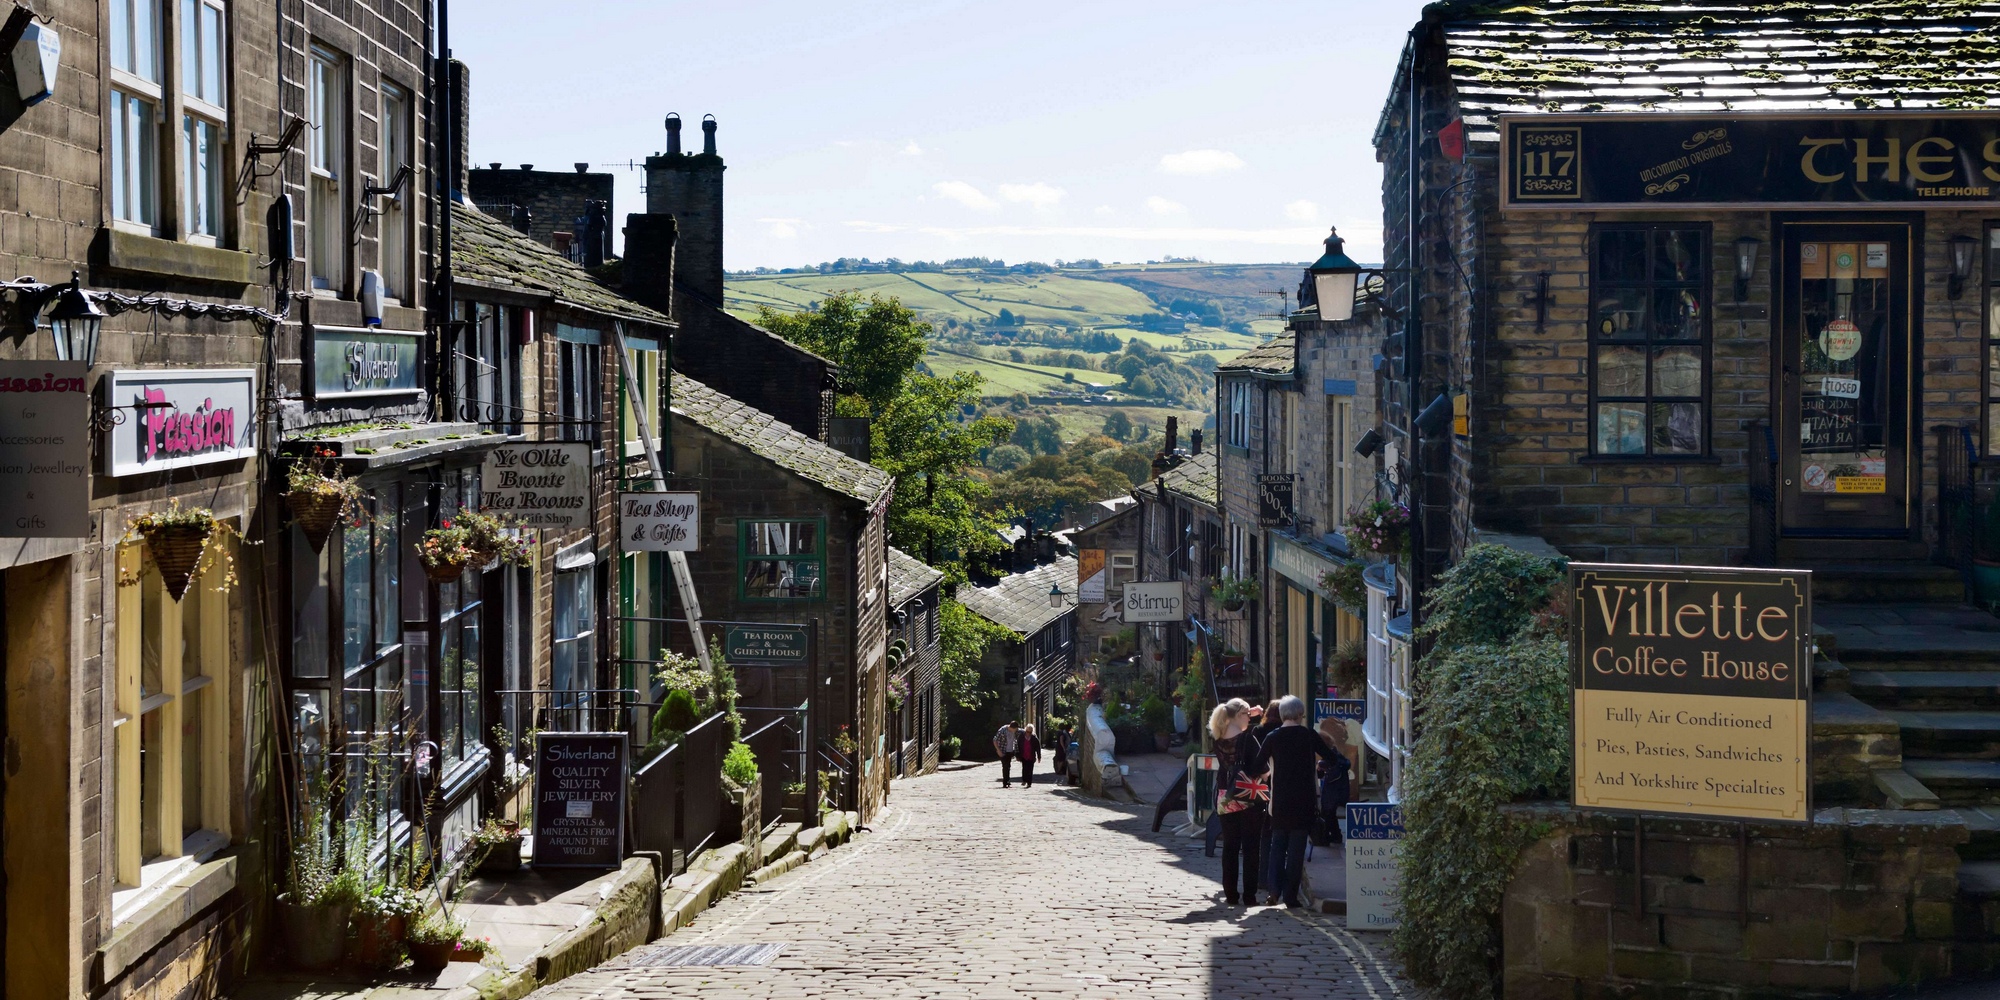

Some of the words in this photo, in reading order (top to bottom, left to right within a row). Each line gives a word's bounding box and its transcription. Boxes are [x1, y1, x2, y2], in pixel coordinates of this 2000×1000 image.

[1523, 151, 1575, 177] 117
[1799, 135, 1955, 183] THE
[1917, 187, 1989, 197] TELEPHONE
[352, 341, 398, 386] Silverland
[1824, 380, 1857, 394] CLOSED
[22, 408, 37, 419] for
[144, 384, 235, 461] Passion
[493, 450, 518, 467] Ye
[521, 449, 570, 467] Olde
[27, 460, 85, 477] Jewellery
[497, 471, 565, 488] Bronte
[26, 491, 34, 499] &
[482, 491, 515, 509] Tea
[517, 491, 584, 509] Rooms
[625, 500, 652, 517] Tea
[653, 500, 695, 521] Shop
[1261, 485, 1293, 525] BOOKS
[16, 514, 46, 529] Gifts
[521, 512, 543, 523] Gift
[545, 512, 573, 525] Shop
[1262, 517, 1279, 525] Vinyl
[631, 523, 646, 541] &
[650, 523, 687, 545] Gifts
[1127, 593, 1180, 614] Stirrup
[1591, 582, 1789, 642] Villette
[763, 632, 793, 640] ROOM
[734, 648, 765, 656] GUEST
[768, 648, 801, 657] HOUSE
[1592, 645, 1688, 678] Coffee
[1701, 650, 1789, 682] House
[1318, 701, 1362, 715] Villette
[1606, 707, 1642, 728] Fully
[1647, 709, 1671, 724] Air
[1676, 710, 1773, 730] Conditioned
[546, 744, 616, 762] Silverland
[1596, 738, 1630, 756] Pies,
[1635, 740, 1690, 759] Pasties,
[1695, 743, 1783, 763] Sandwiches
[552, 767, 609, 778] QUALITY
[559, 779, 601, 789] SILVER
[1594, 771, 1625, 786] And
[1629, 772, 1699, 791] Yorkshire
[1704, 777, 1785, 798] Specialties
[543, 791, 617, 803] JEWELLERY
[553, 818, 597, 827] CRYSTALS
[598, 819, 605, 827] &
[1351, 807, 1403, 826] Villett
[541, 828, 589, 836] MINERALS
[590, 828, 615, 836] FROM
[1350, 828, 1383, 838] Coffee
[549, 837, 588, 845] AROUND
[590, 837, 609, 846] THE
[563, 847, 596, 855] WORLD
[1353, 846, 1374, 856] Hot
[1378, 847, 1385, 856] &
[1355, 859, 1398, 870] Sandwic
